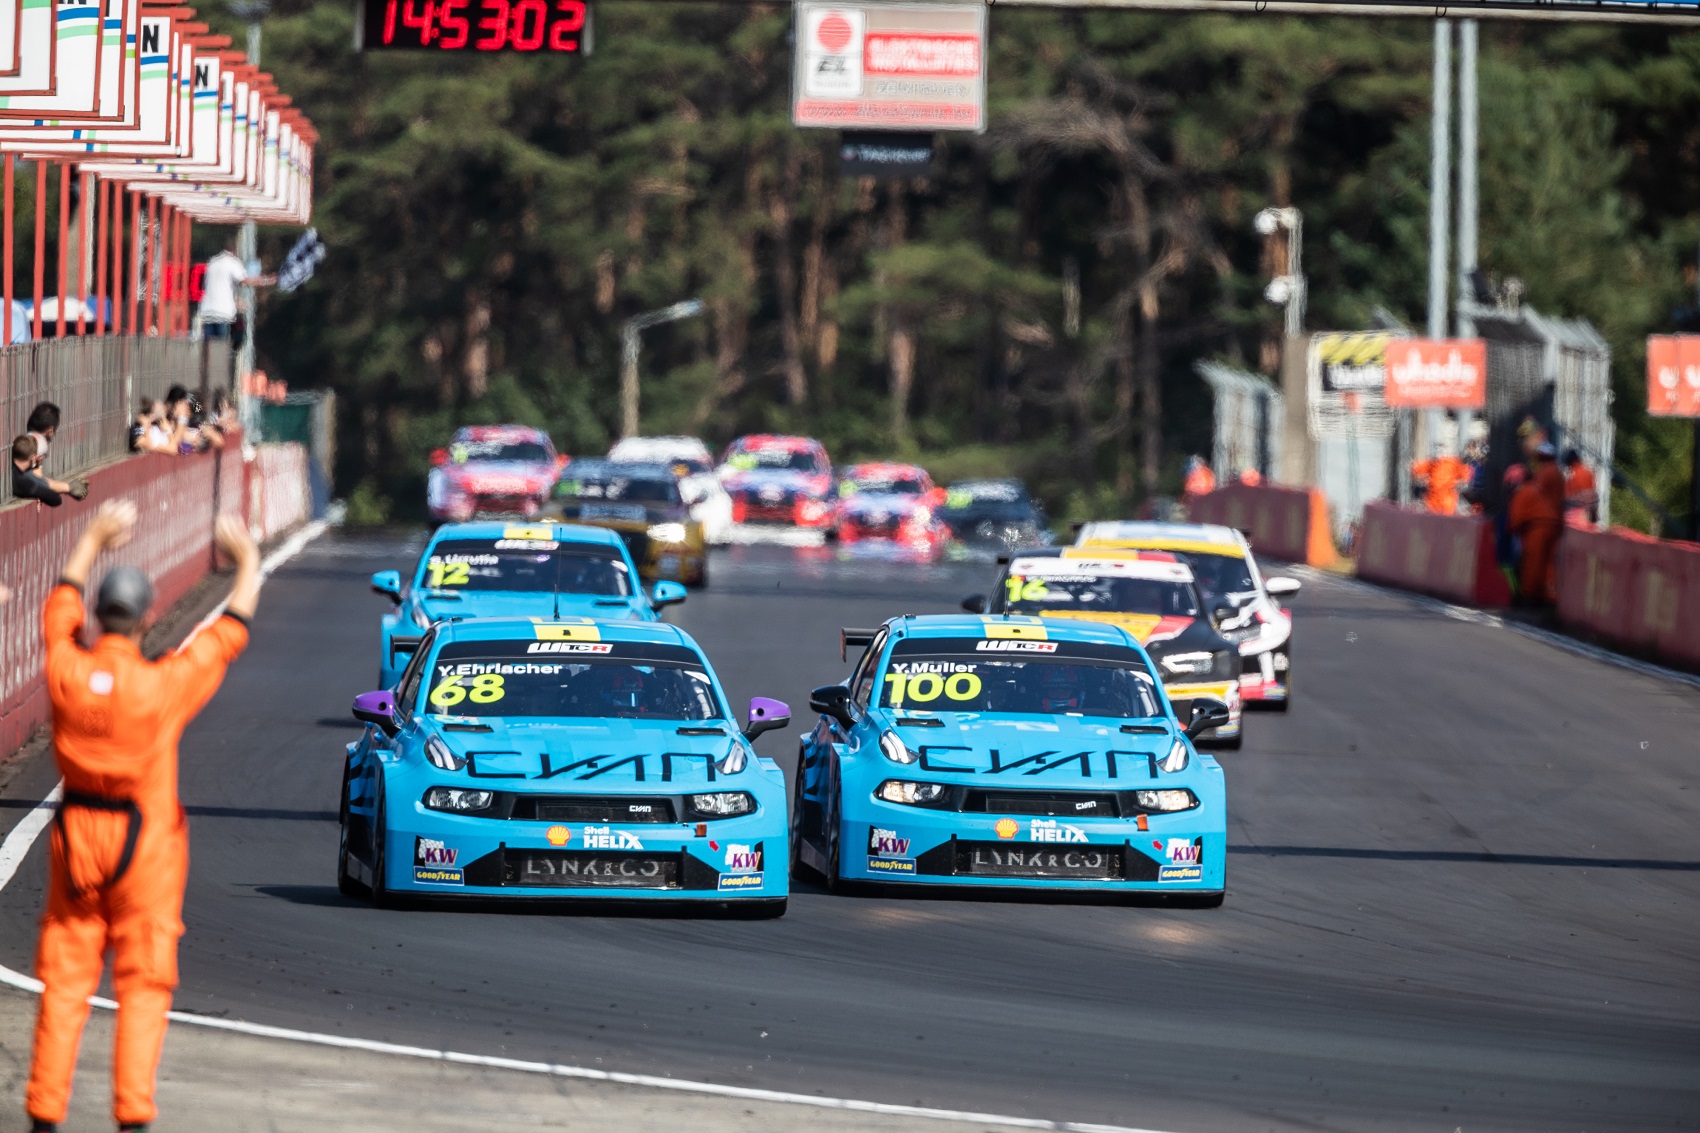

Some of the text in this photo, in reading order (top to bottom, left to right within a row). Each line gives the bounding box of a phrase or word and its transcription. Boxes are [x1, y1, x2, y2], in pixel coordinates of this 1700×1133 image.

[428, 562, 470, 587] 12
[1005, 578, 1050, 602] 16
[430, 673, 505, 706] 68
[885, 673, 982, 703] 100
[584, 826, 610, 835] Shell
[1030, 819, 1056, 829] Shell
[583, 833, 644, 850] HELIX
[1030, 827, 1089, 843] HELIX
[878, 837, 911, 855] KW
[1172, 845, 1201, 862] KW
[425, 847, 458, 865] KW
[732, 851, 761, 869] KW
[869, 861, 913, 870] GOODYEAR
[416, 871, 461, 881] GOODYEAR
